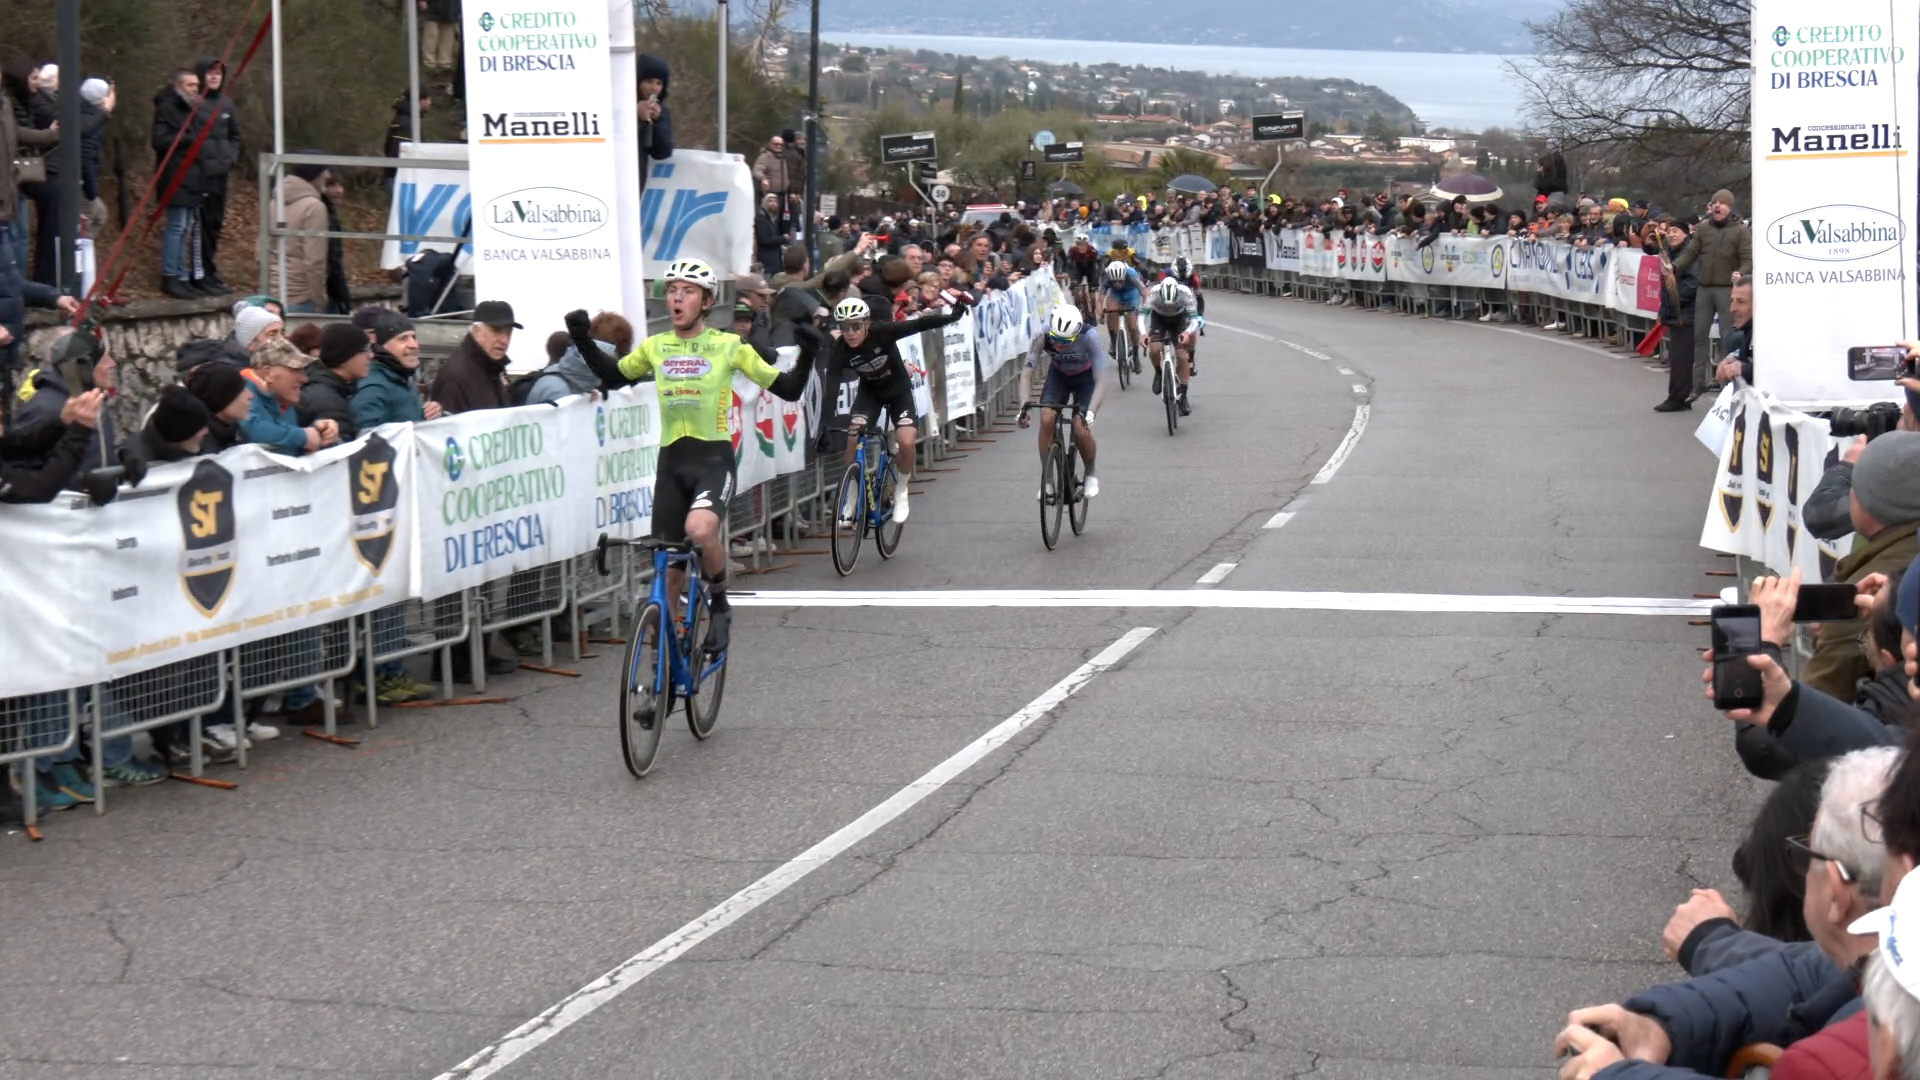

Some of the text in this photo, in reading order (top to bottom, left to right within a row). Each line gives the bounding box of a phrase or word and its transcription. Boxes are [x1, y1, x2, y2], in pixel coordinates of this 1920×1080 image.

[500, 12, 576, 30] CREDITO
[477, 32, 598, 52] COOPERATIVO
[1796, 24, 1882, 44] CREDITO
[479, 54, 576, 73] DI BRESCIA
[1770, 46, 1905, 68] COOPERATIVO
[1771, 69, 1879, 90] DI BRESCIA
[482, 112, 601, 137] Manelli
[1807, 123, 1866, 132] concessionaria
[1771, 124, 1903, 152] Manelli
[1799, 219, 1898, 244] Valsabbina
[483, 248, 612, 261] BANCA VALSABBINA
[1828, 247, 1850, 256] 1898
[1765, 268, 1906, 285] BANCA VALSABBINA
[667, 367, 700, 375] STORE
[468, 421, 544, 471] CREDITO
[443, 535, 468, 574] DI
